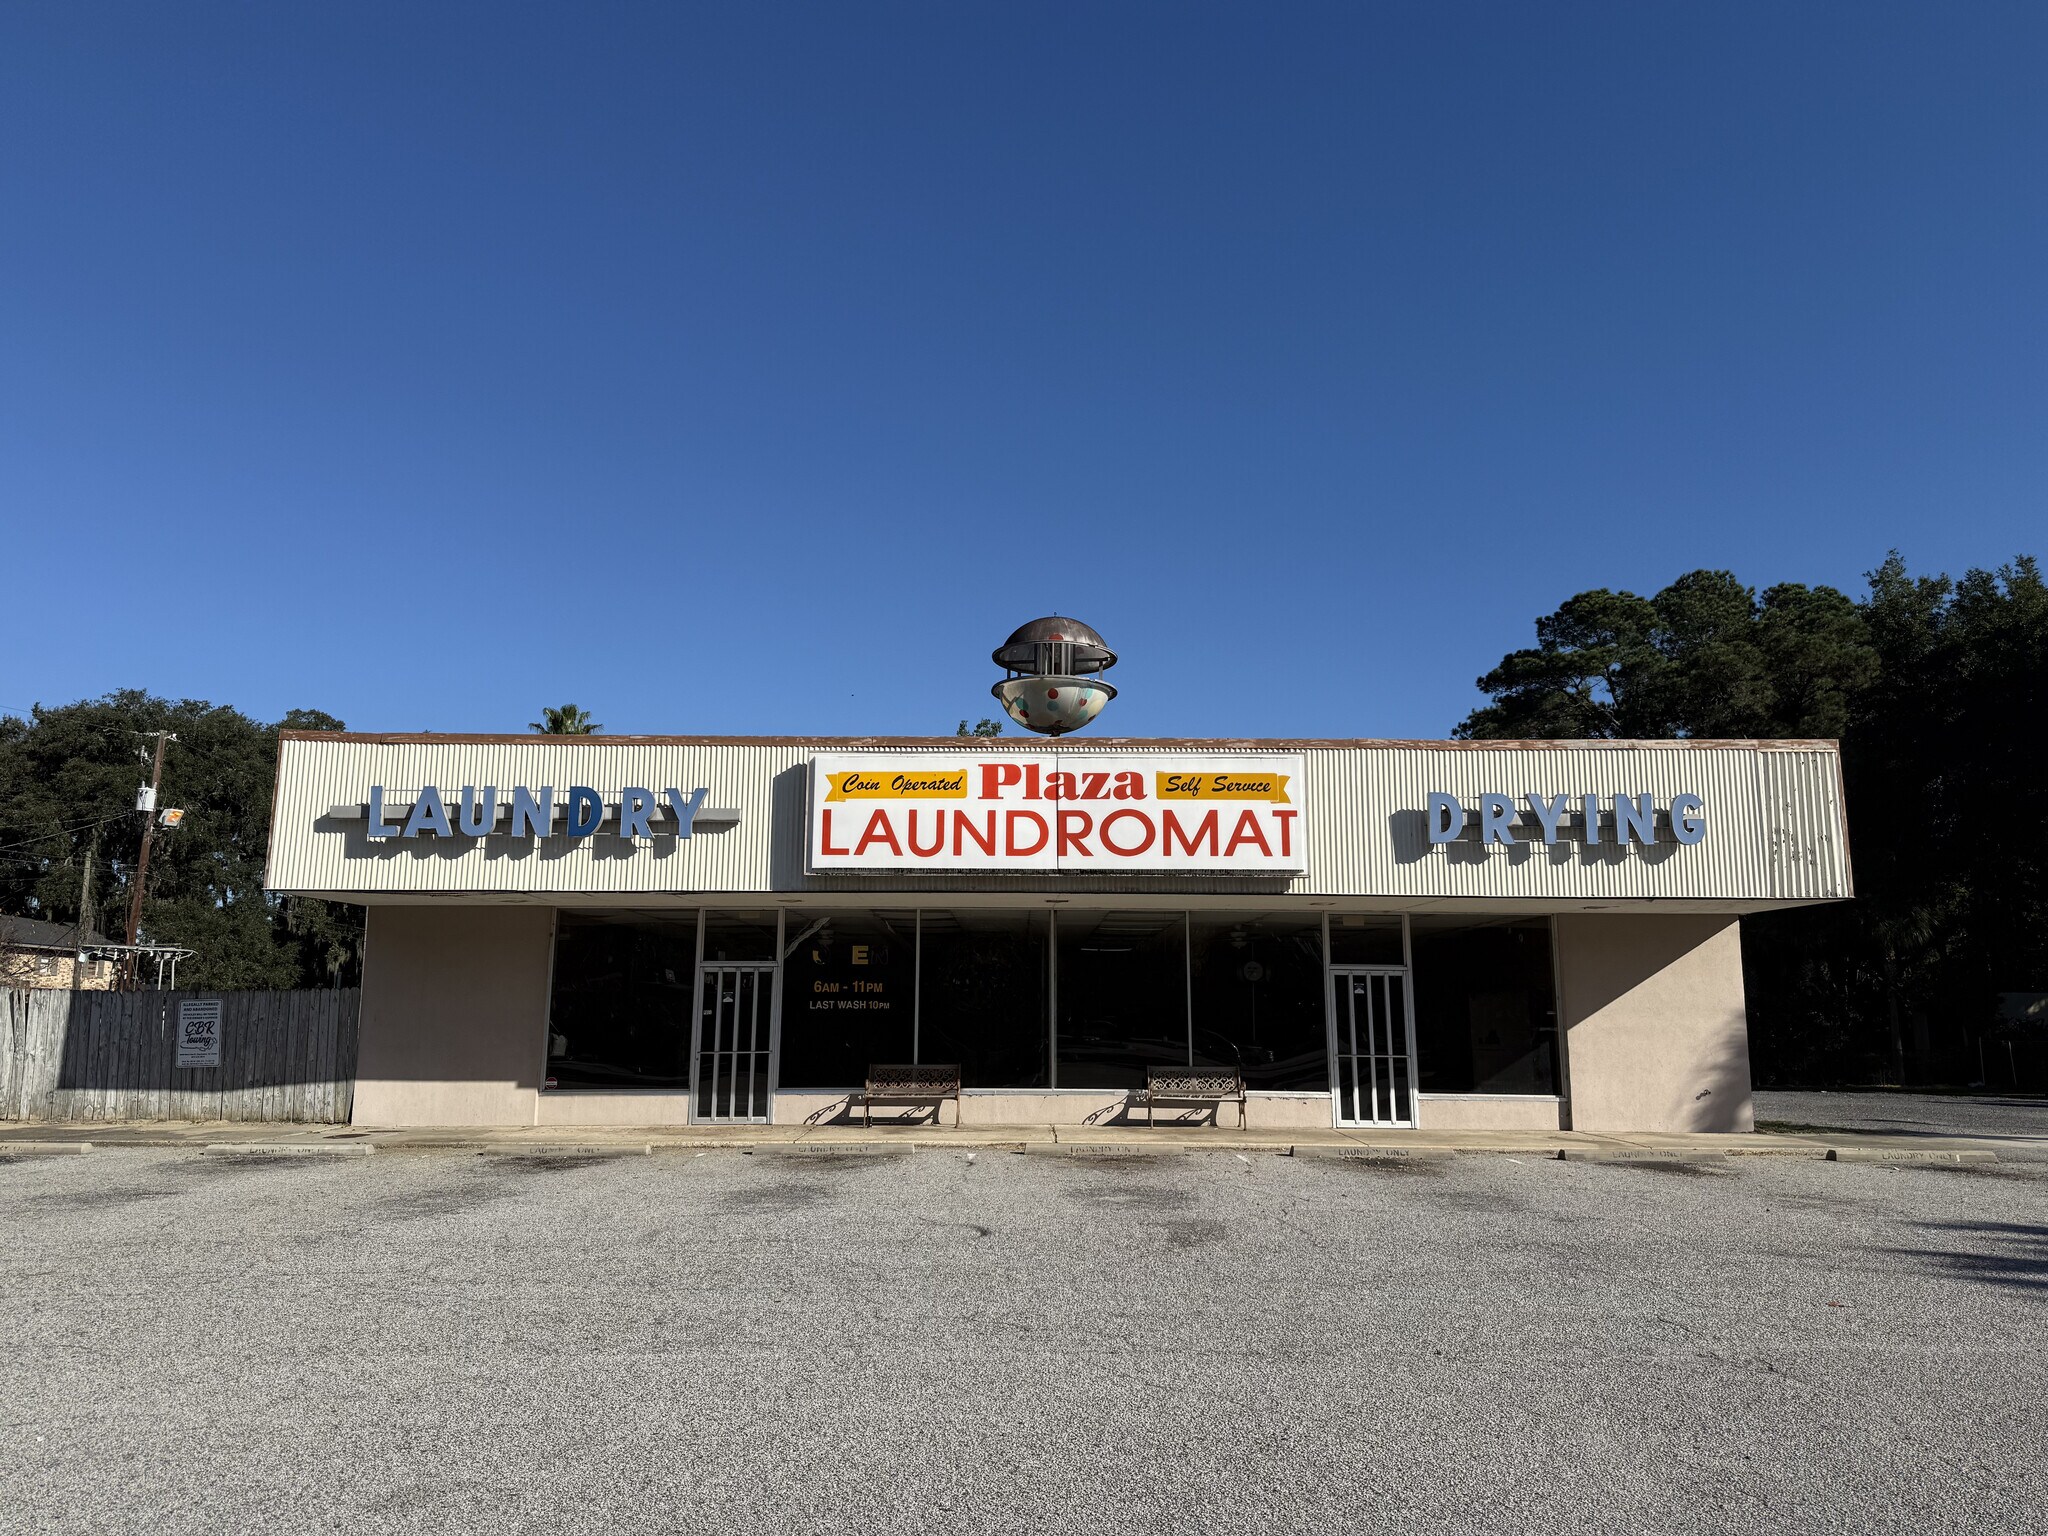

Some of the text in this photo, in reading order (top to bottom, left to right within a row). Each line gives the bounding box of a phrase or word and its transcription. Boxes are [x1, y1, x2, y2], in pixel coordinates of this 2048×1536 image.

[842, 774, 962, 794] Coin Operated
[978, 763, 1147, 801] Plaza
[1165, 775, 1271, 797] Self Service
[368, 785, 710, 839] LAUNDRY
[1426, 791, 1706, 846] DRYING
[821, 808, 1298, 858] LAUNDROMAT
[813, 980, 840, 993] 6AM
[852, 980, 883, 993] 11PM
[809, 1000, 890, 1009] LAST WASH 10PM
[185, 1020, 215, 1035] CBR
[185, 1033, 211, 1047] Towing
